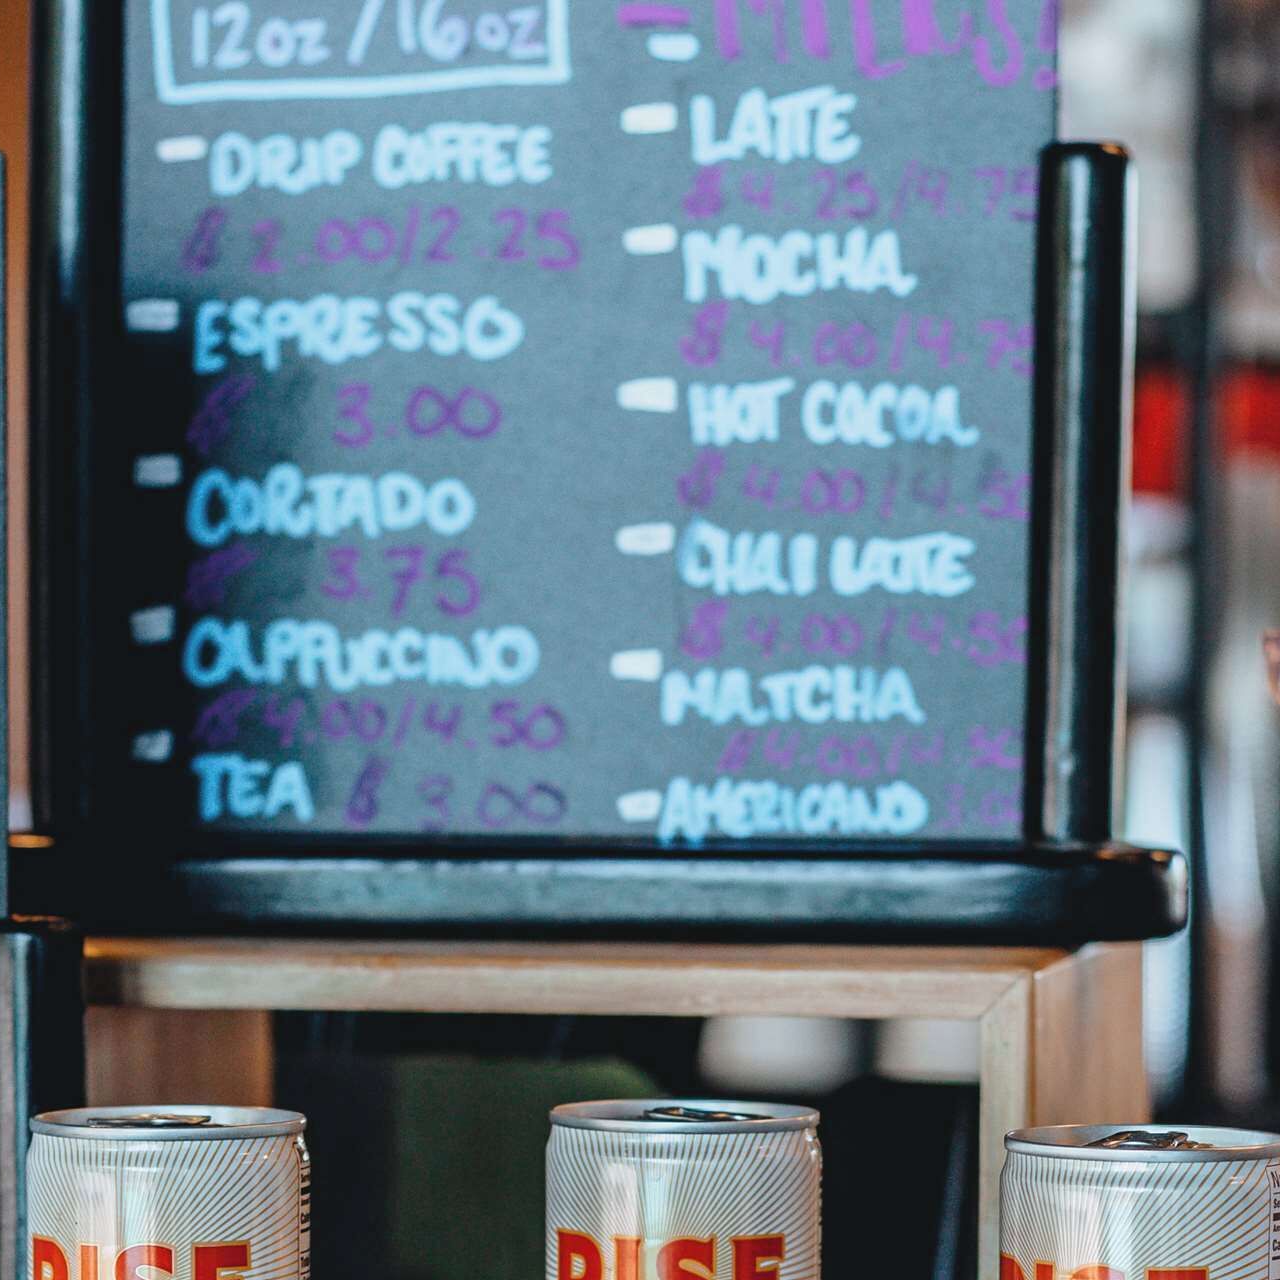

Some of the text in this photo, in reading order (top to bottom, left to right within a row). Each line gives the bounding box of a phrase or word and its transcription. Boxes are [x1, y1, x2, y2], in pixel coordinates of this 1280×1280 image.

[210, 124, 552, 194] DRIP COFFEE
[691, 86, 859, 163] LATTE
[683, 227, 919, 304] MOCHA
[194, 291, 522, 373] ESPRESSO
[688, 381, 979, 444] HOT COCOA
[186, 465, 475, 545] CORTADO
[679, 518, 975, 596] CHAI LATTE
[660, 668, 924, 725] MATCHA
[190, 753, 314, 823] TEA
[658, 777, 927, 841] AMERICANO
